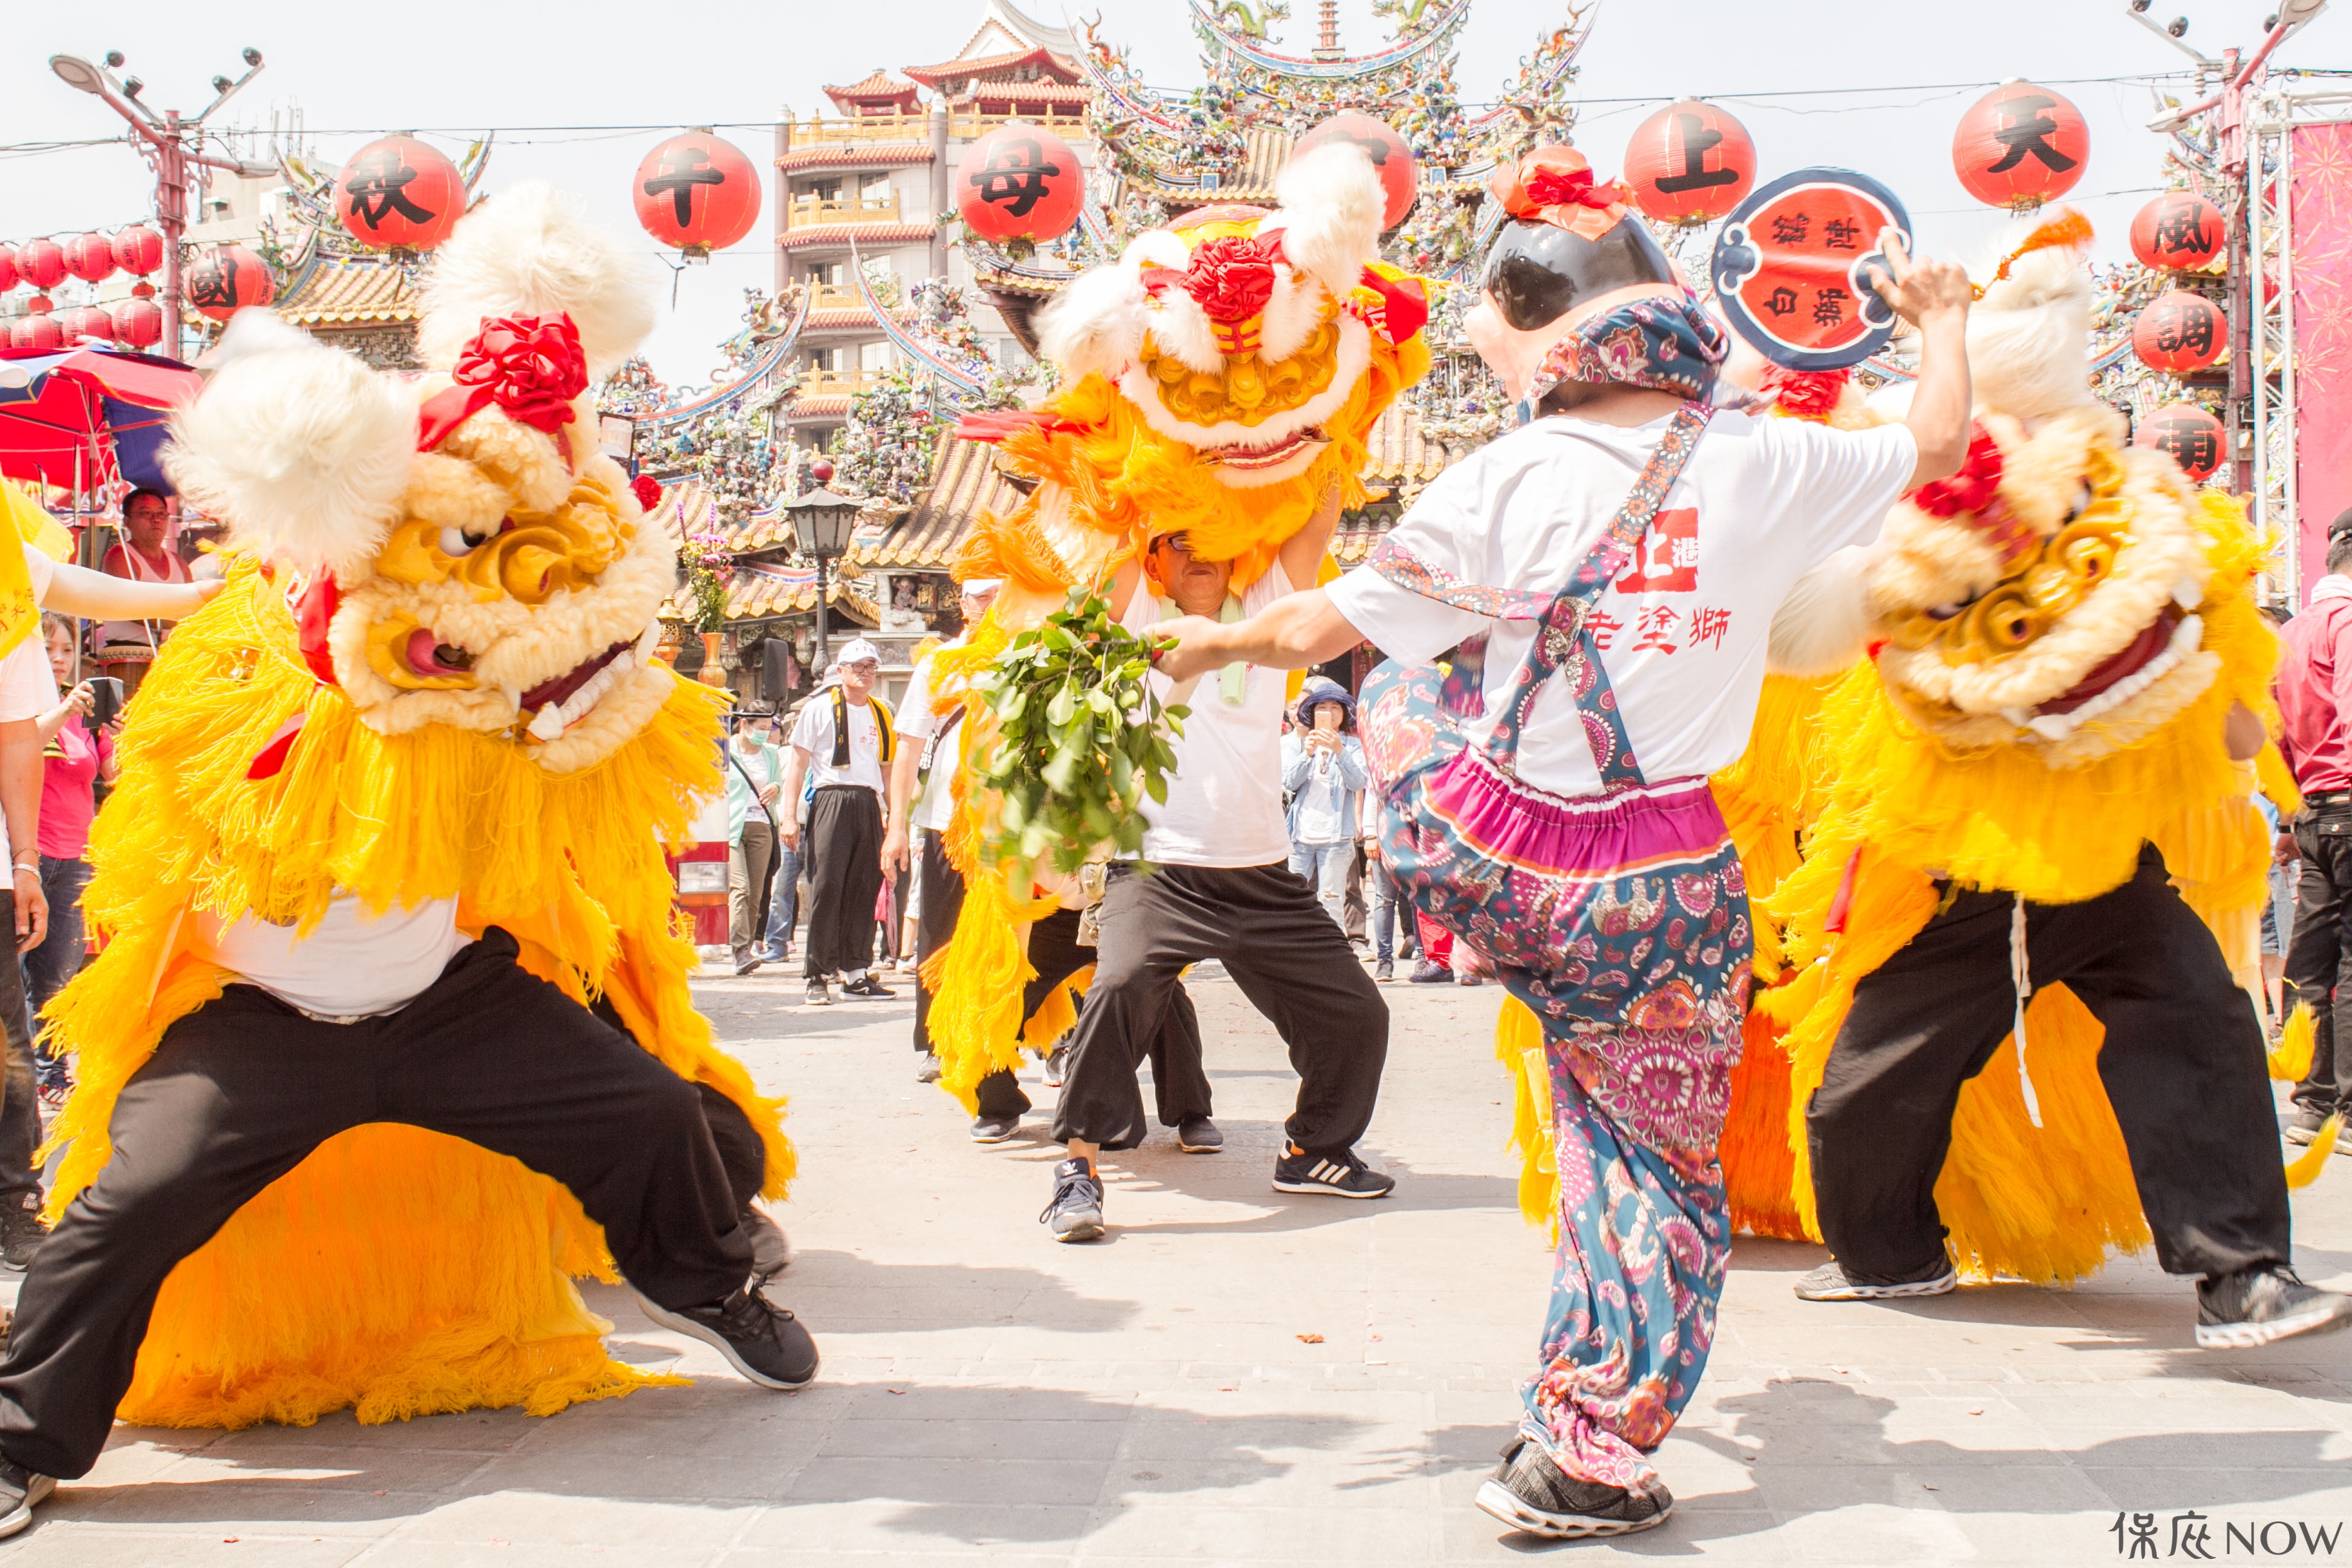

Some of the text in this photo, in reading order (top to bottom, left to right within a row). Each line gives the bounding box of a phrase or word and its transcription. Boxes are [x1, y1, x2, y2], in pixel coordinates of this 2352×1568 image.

[1655, 113, 1740, 194] 上
[1987, 94, 2078, 174] 天
[345, 149, 436, 230] 秋
[643, 147, 725, 228] 千
[970, 138, 1060, 218] 母
[2154, 201, 2212, 255] 風
[190, 248, 238, 308] 國
[2152, 303, 2213, 357] 調
[2154, 419, 2218, 472] 雨
[1586, 605, 1732, 655] 老塗獅
